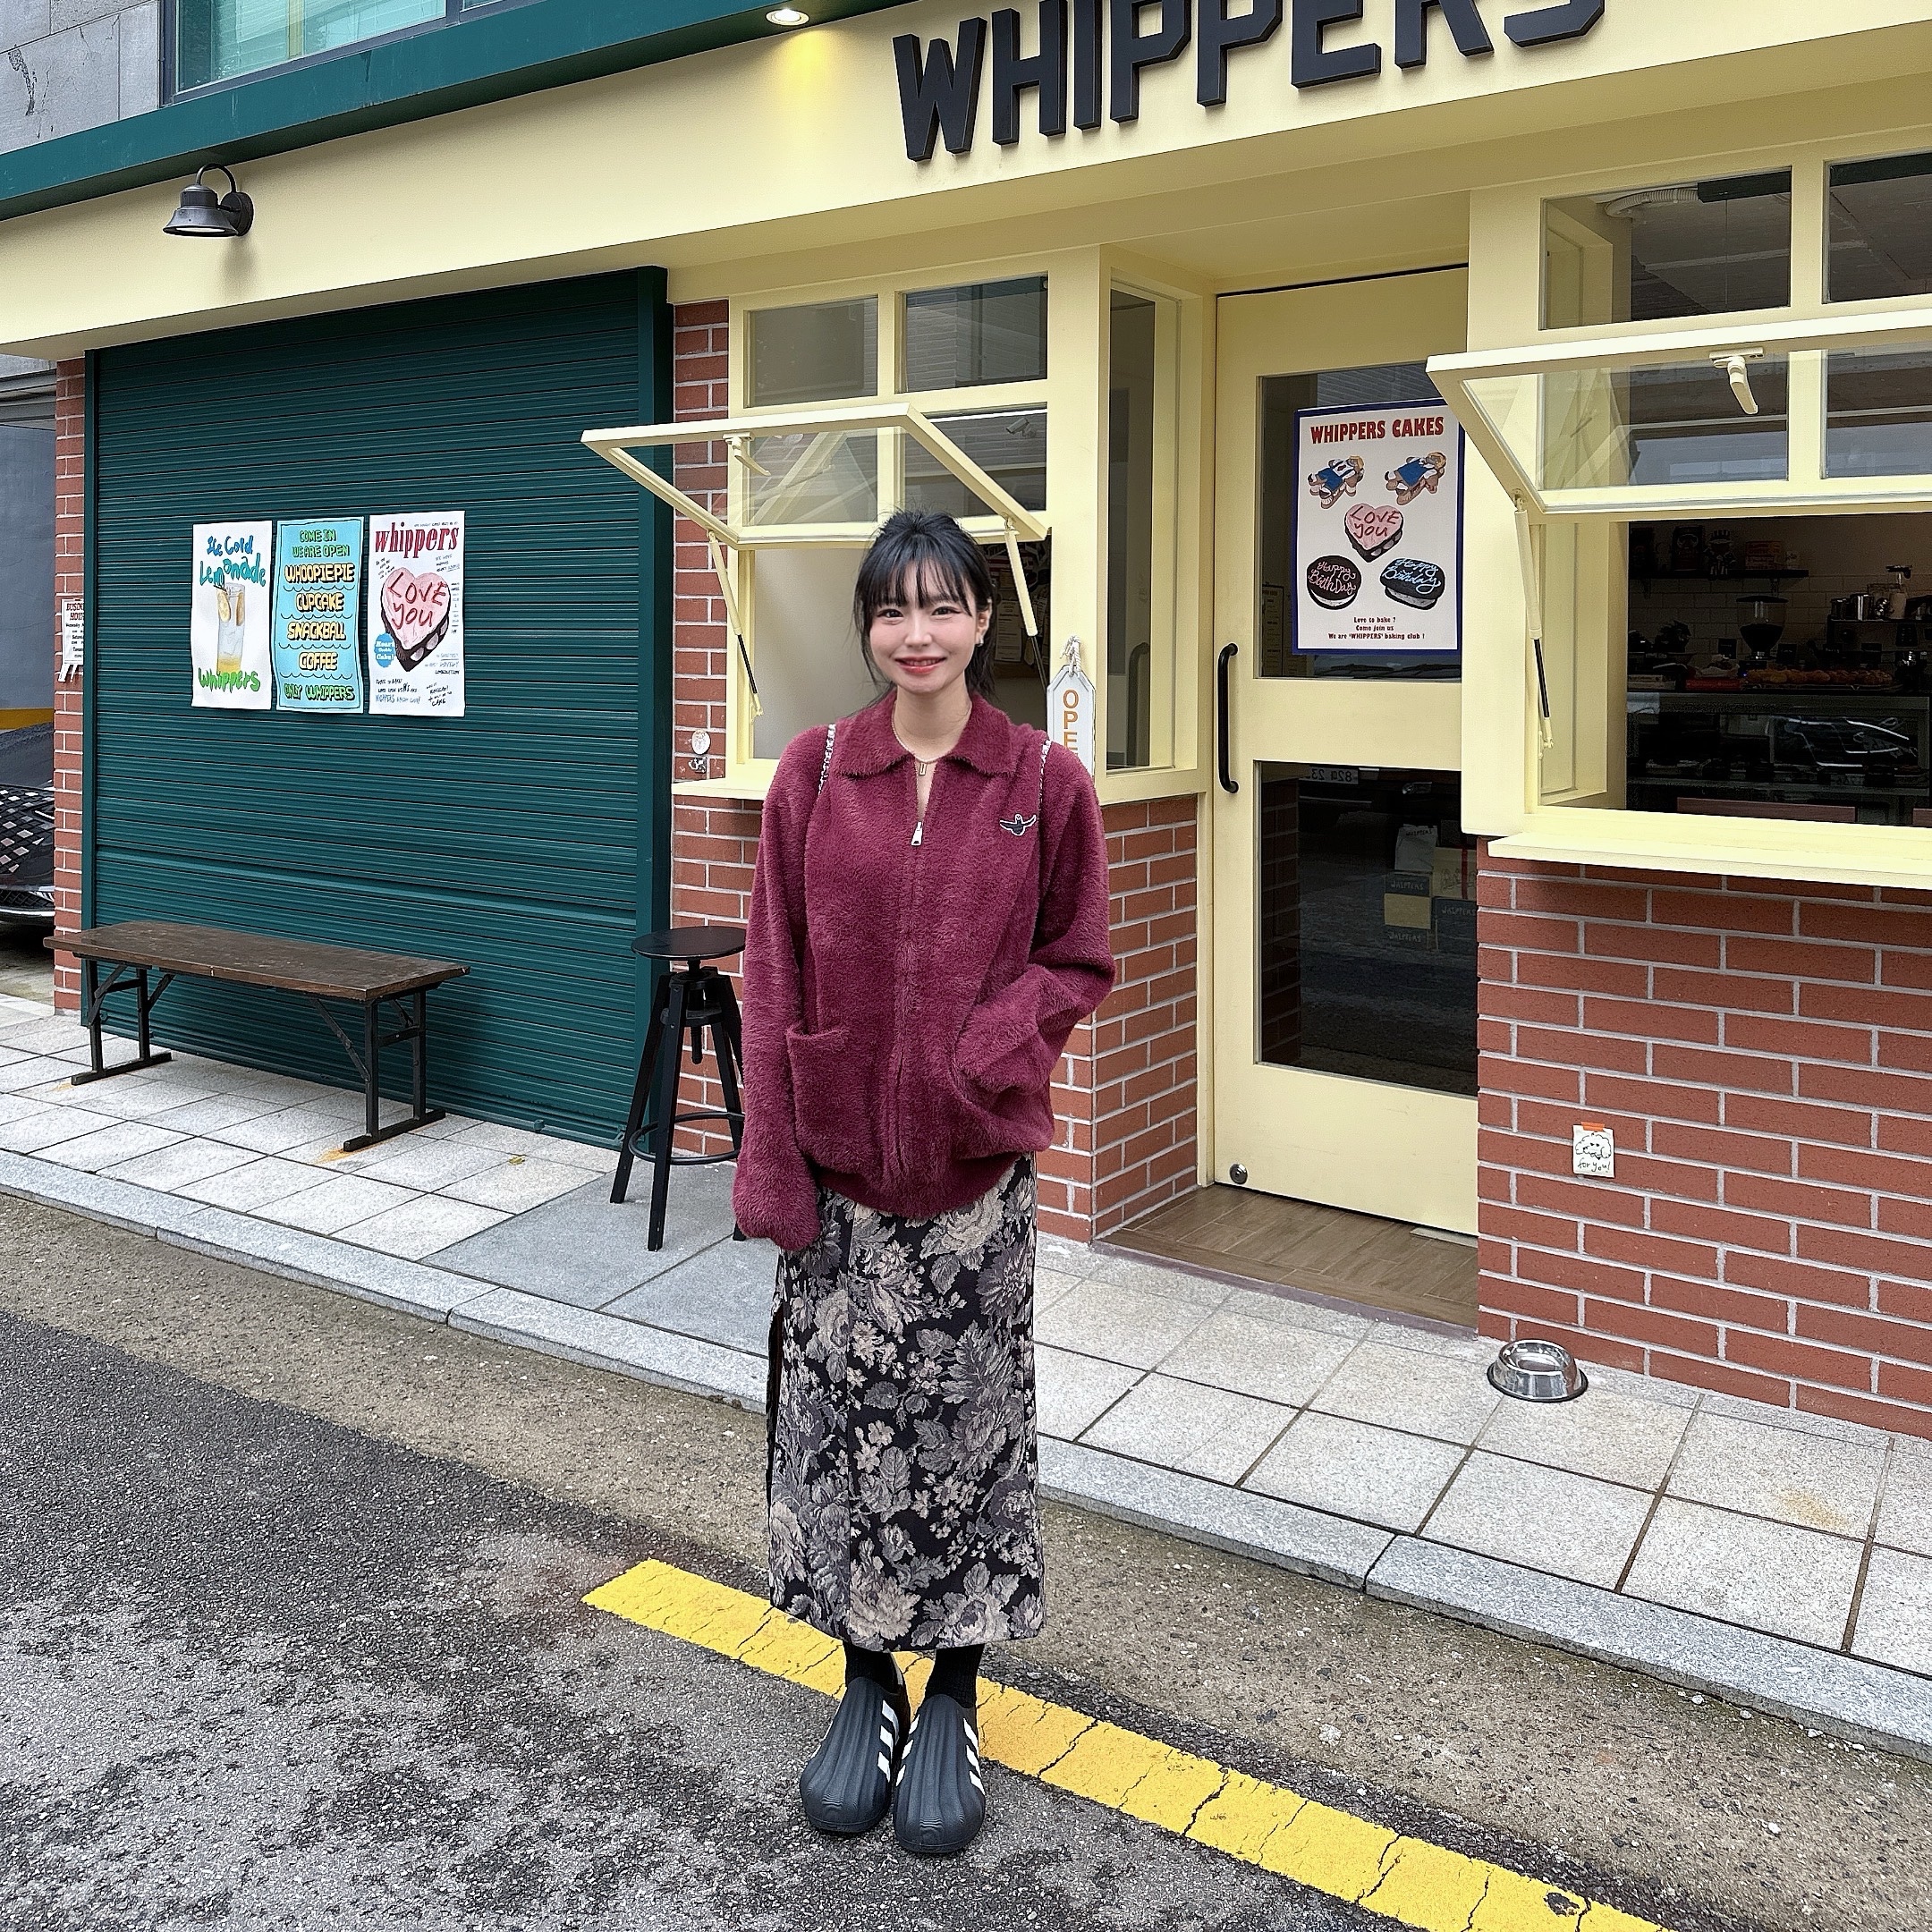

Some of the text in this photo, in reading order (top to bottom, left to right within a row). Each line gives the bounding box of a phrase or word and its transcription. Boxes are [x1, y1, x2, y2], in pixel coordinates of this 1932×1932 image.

[1310, 417, 1444, 444] WHIPPERS CAKES
[1350, 505, 1400, 524] LOVE
[225, 535, 253, 555] Cold
[300, 530, 336, 543] COME IN
[375, 521, 459, 559] whippers
[304, 546, 322, 558] ARE
[323, 545, 350, 557] OPEN
[199, 552, 267, 587] Lemonade
[284, 563, 355, 584] WHOOPIEPIE
[1318, 561, 1356, 581] Happy
[387, 572, 448, 606] LOVE
[296, 592, 345, 613] CUPCAKE
[287, 621, 347, 640] SNACKBALL
[299, 652, 338, 671] COFFEE
[199, 667, 260, 693] Whippers
[305, 684, 355, 701] WHIPPERS
[1063, 690, 1079, 757] OPE
